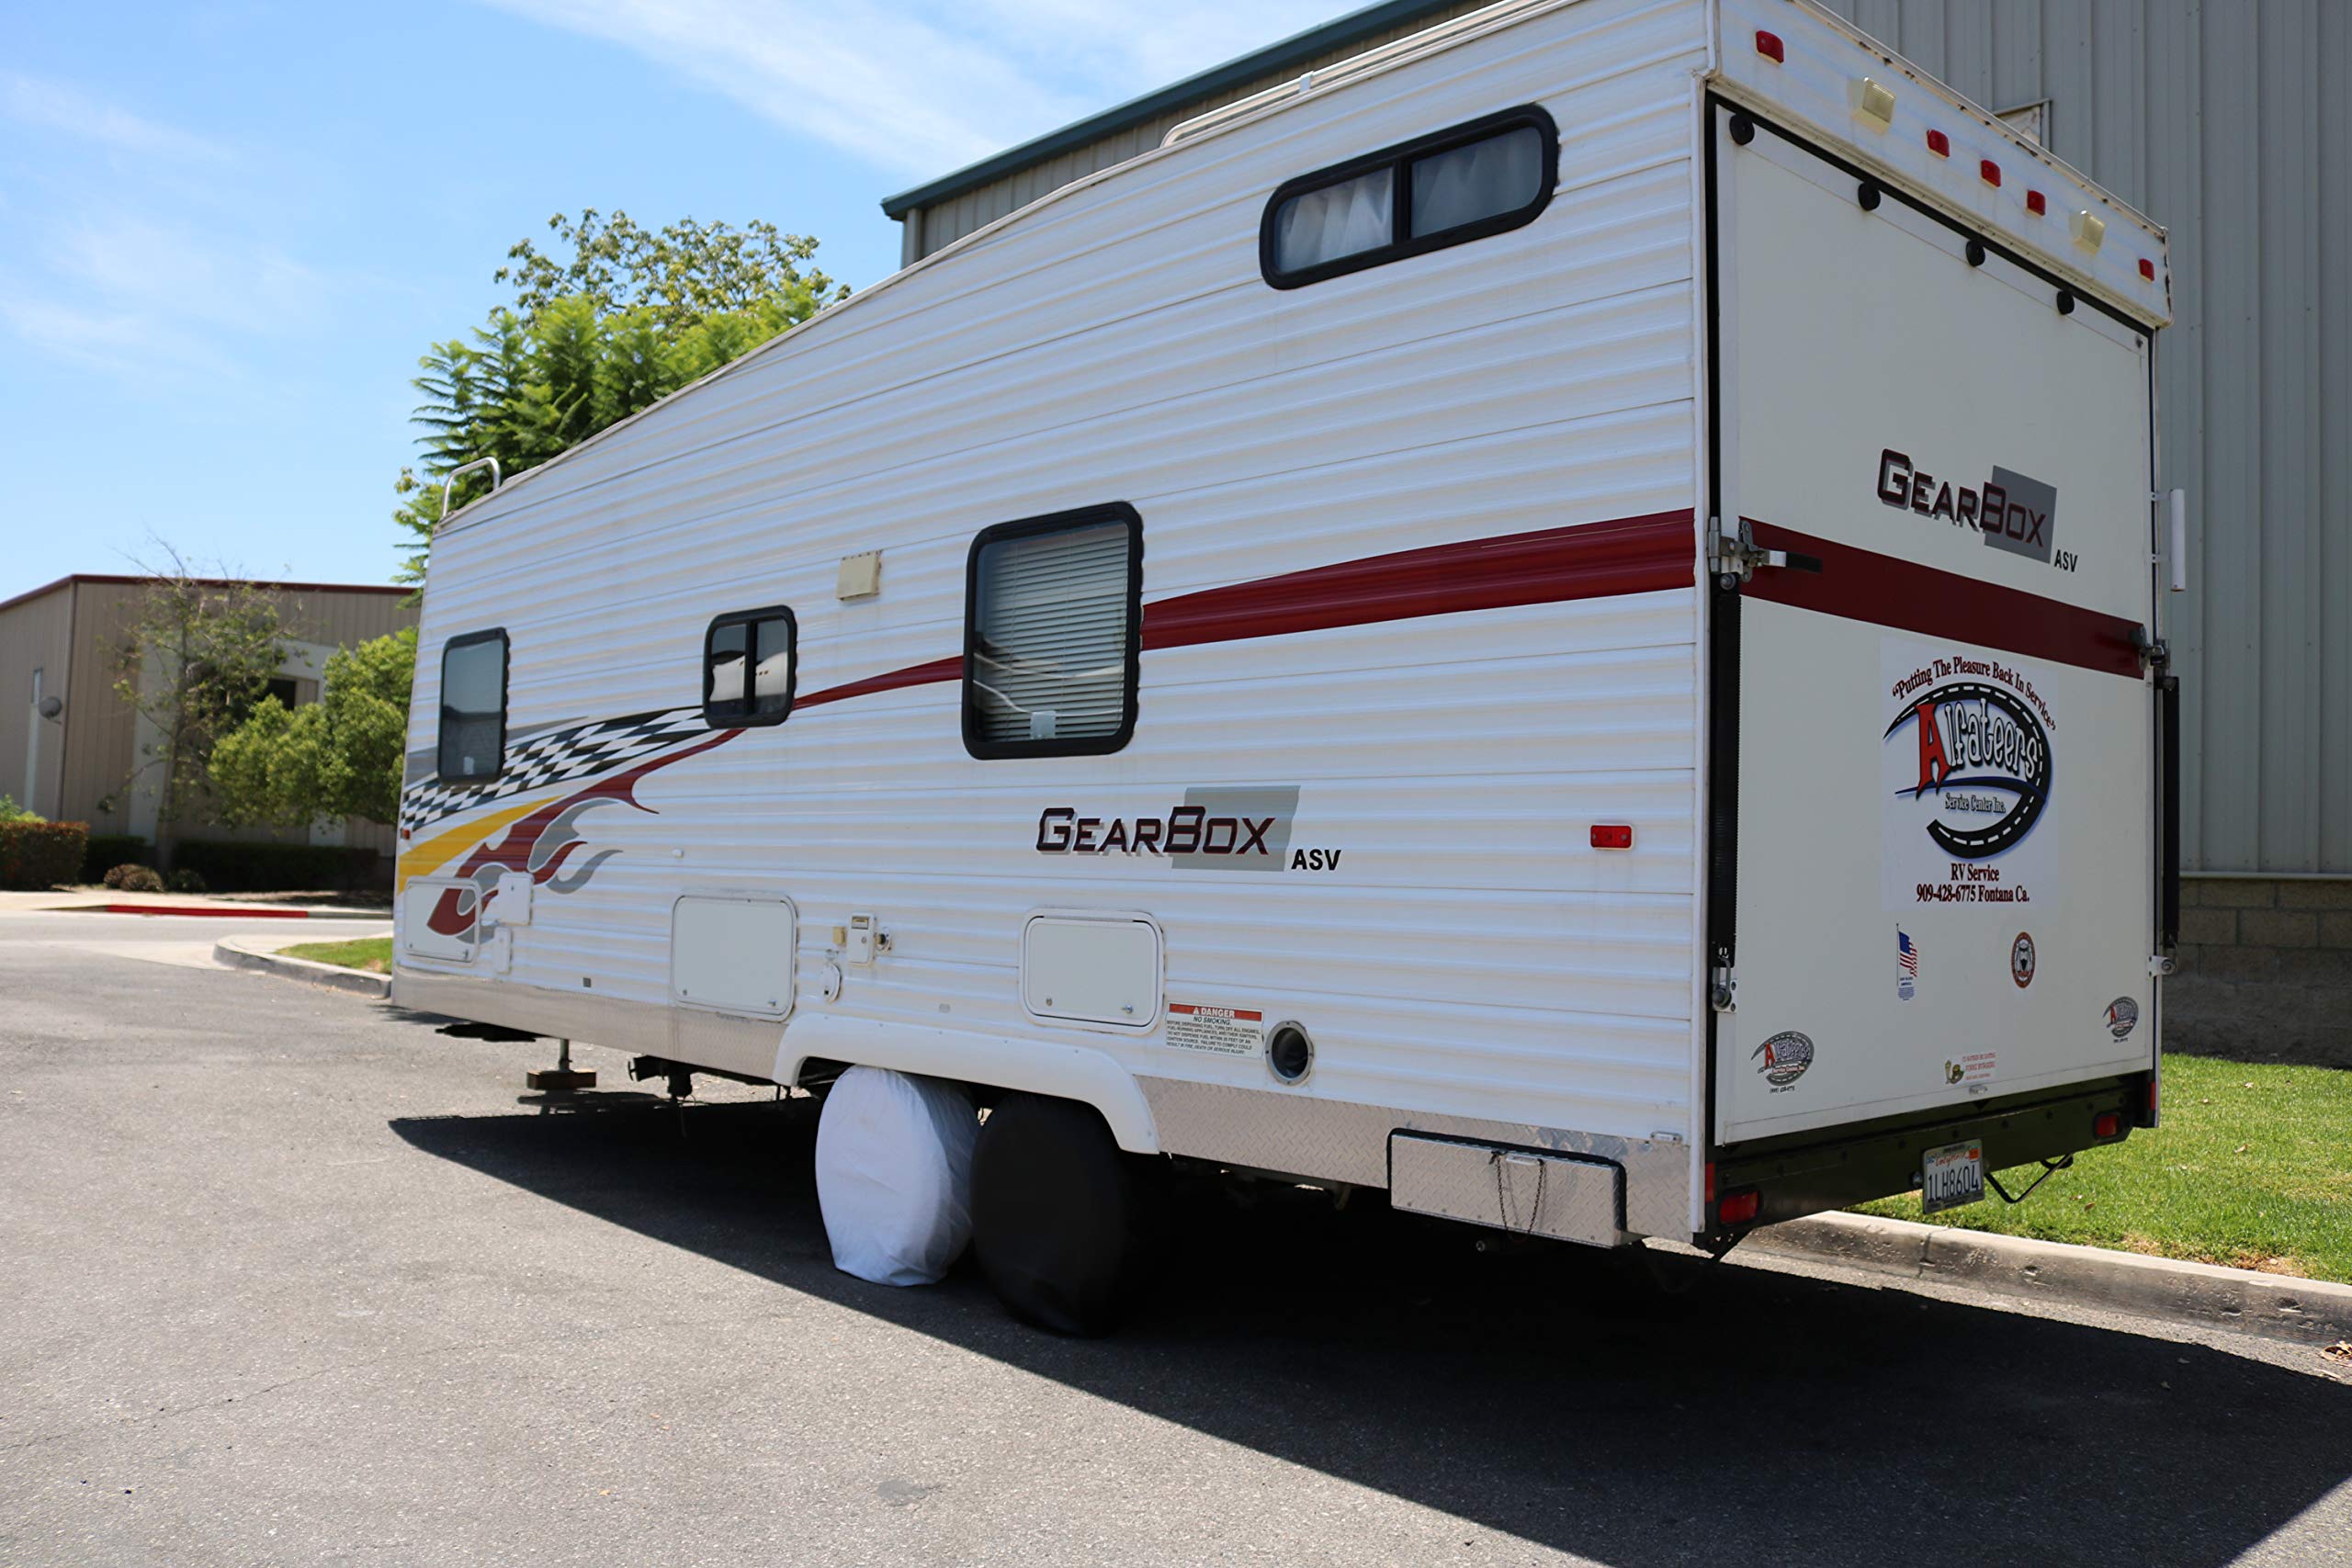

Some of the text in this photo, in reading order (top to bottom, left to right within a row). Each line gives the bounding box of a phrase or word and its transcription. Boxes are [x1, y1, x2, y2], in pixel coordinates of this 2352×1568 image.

[2053, 549, 2078, 572] ASV
[1933, 659, 1951, 678] The
[1952, 657, 1991, 676] Pleasure
[1993, 661, 2014, 685] Back
[2015, 672, 2025, 694] In
[1915, 698, 2039, 797] Alfateers
[1945, 793, 2006, 814] Service Center Inc.
[1291, 848, 1342, 871] ASV
[1951, 863, 1999, 882] RV Service
[1917, 884, 2030, 902] 909-428-6775 Fontana Ca.
[1201, 1009, 1235, 1018] DANGER
[1928, 1165, 1979, 1202] 1LH8604
